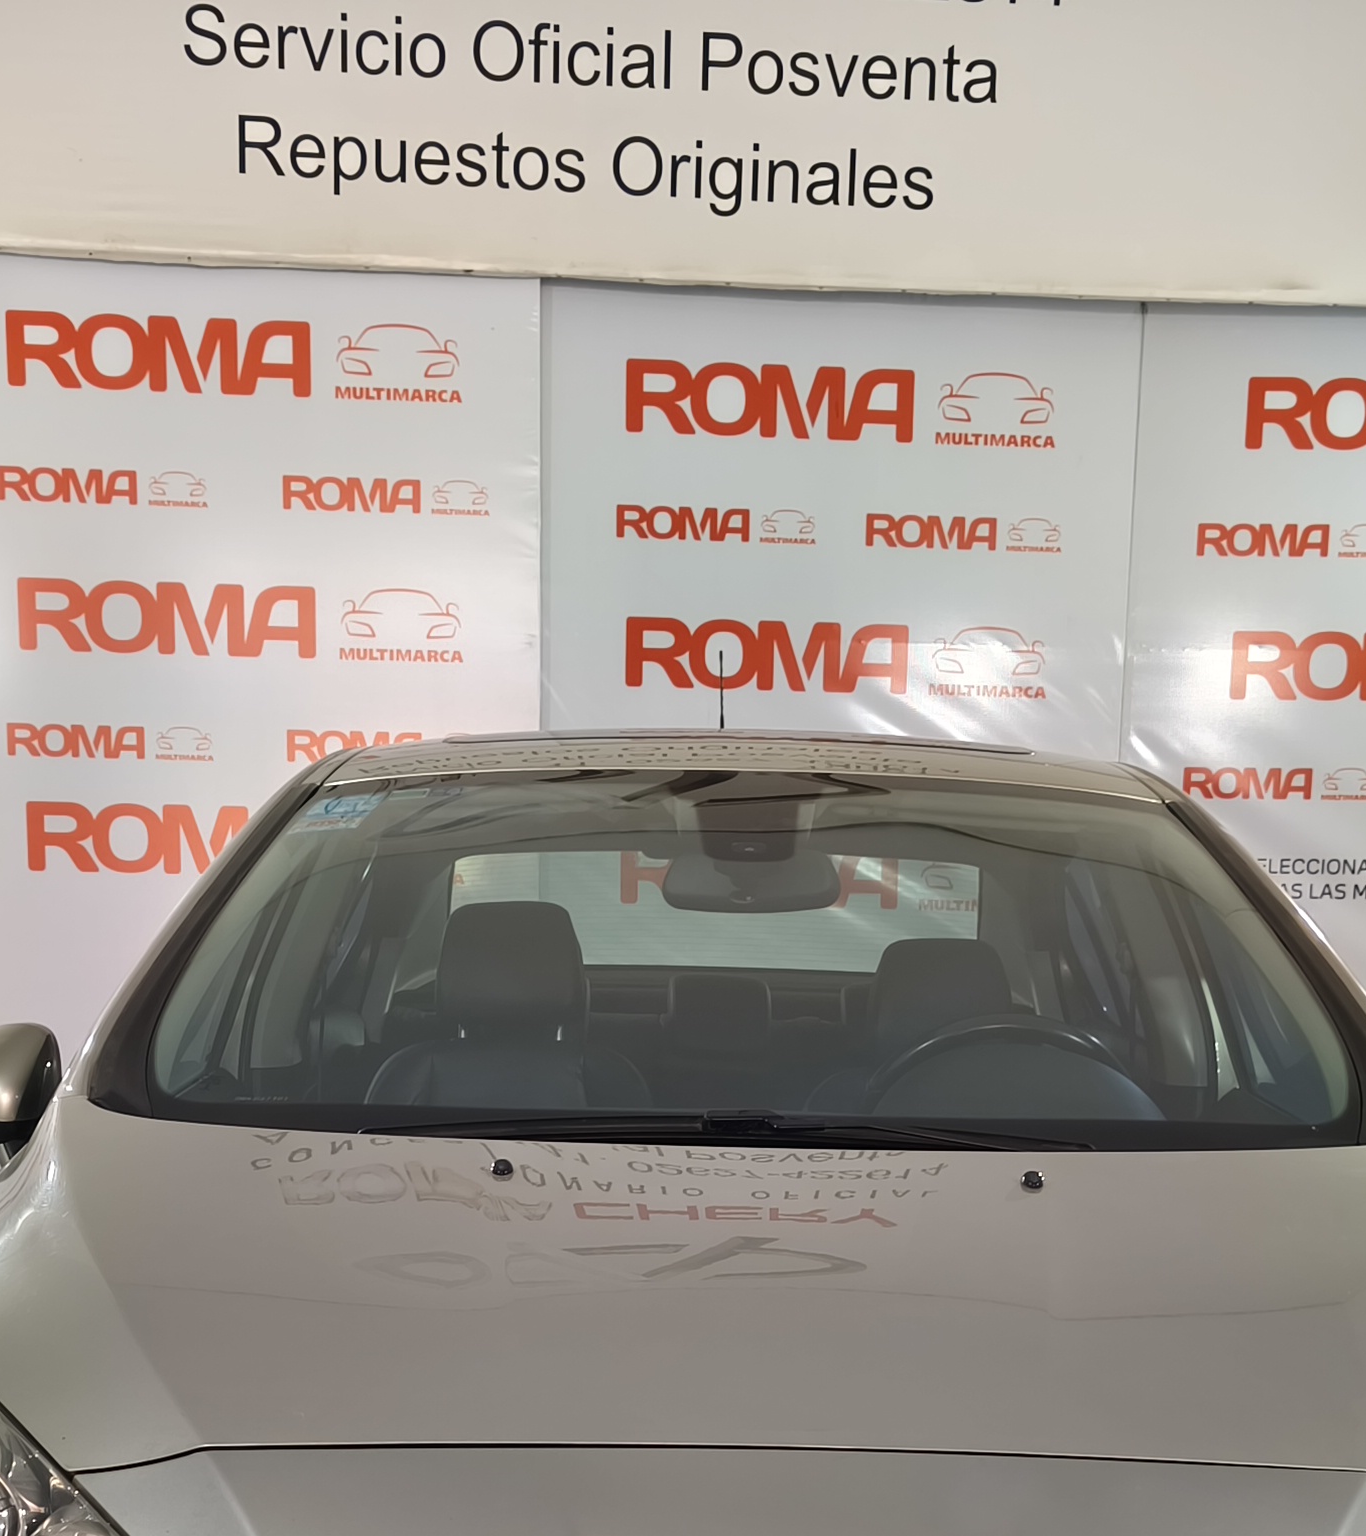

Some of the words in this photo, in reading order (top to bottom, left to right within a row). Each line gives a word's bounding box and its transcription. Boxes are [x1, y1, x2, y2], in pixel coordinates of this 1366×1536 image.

[184, 4, 446, 78] Servicio
[473, 20, 671, 89] Oficial
[702, 32, 997, 103] Posventa
[238, 115, 586, 195] Repuestos
[613, 136, 934, 216] Originales
[5, 309, 312, 399] ROMA
[334, 387, 463, 404] MULTIMARCA
[625, 358, 915, 445] ROMA
[934, 432, 1056, 449] MULTIMARCA
[281, 475, 422, 515] ROMA
[615, 504, 750, 544] ROMA
[865, 513, 997, 552] ROMA
[1196, 523, 1330, 559] ROMA
[17, 578, 317, 660] ROMA
[339, 648, 464, 664] MULTIMARCA
[625, 617, 909, 695] ROMA
[928, 684, 1047, 700] MULTIMARCA
[6, 722, 145, 761] ROMA
[1183, 767, 1313, 802] ROMA
[26, 801, 250, 876] ROM
[1309, 884, 1347, 900] LAS
